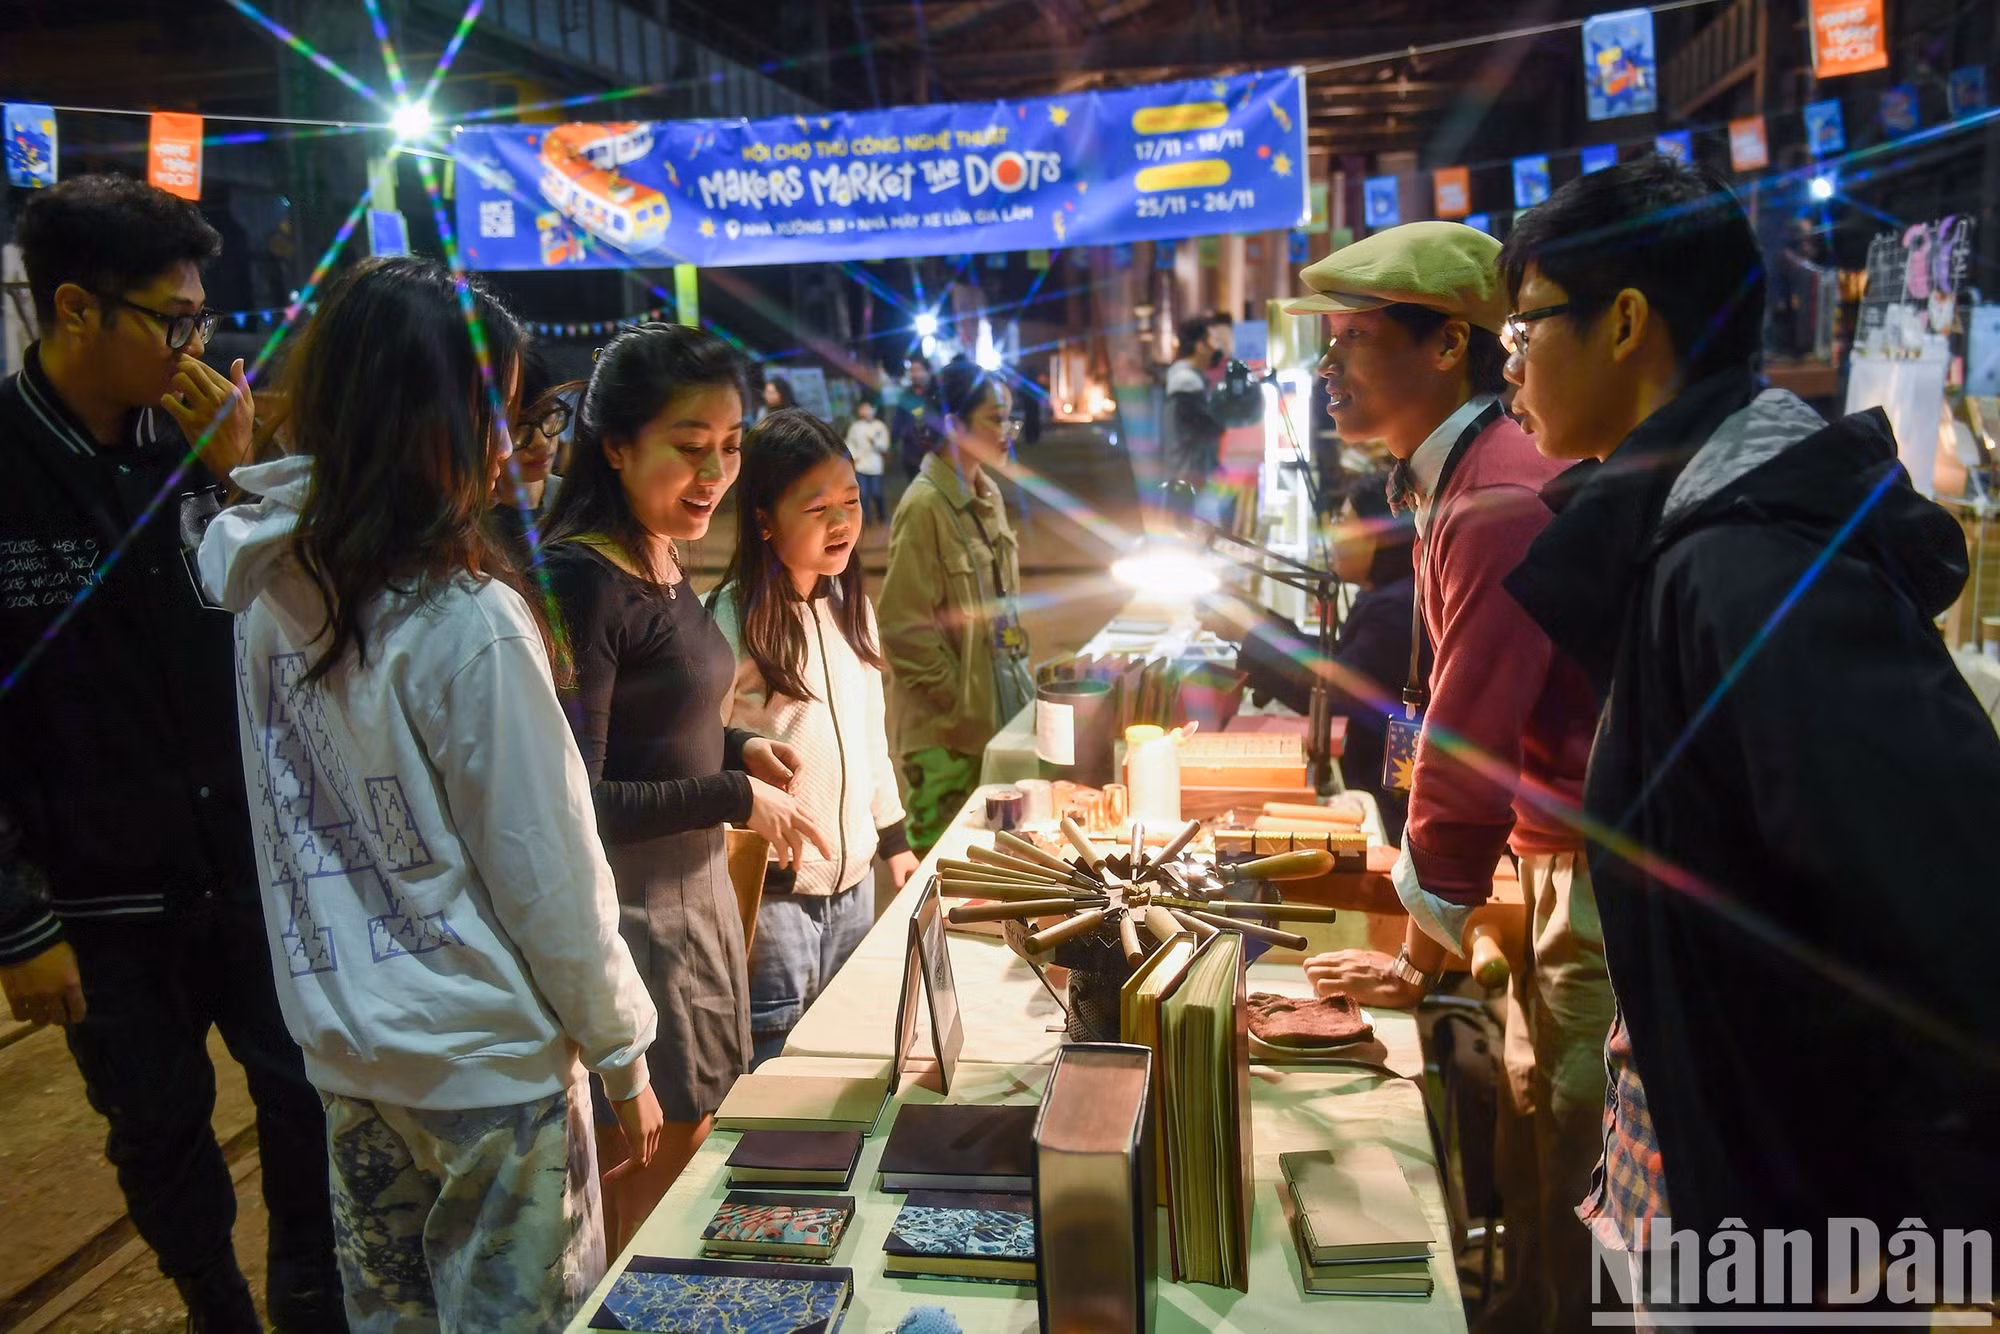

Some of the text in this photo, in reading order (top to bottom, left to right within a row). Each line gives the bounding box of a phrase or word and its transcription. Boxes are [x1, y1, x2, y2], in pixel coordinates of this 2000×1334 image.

[1135, 138, 1181, 161] 17/11
[964, 150, 1061, 197] DOTS
[1136, 195, 1187, 218] 25/11
